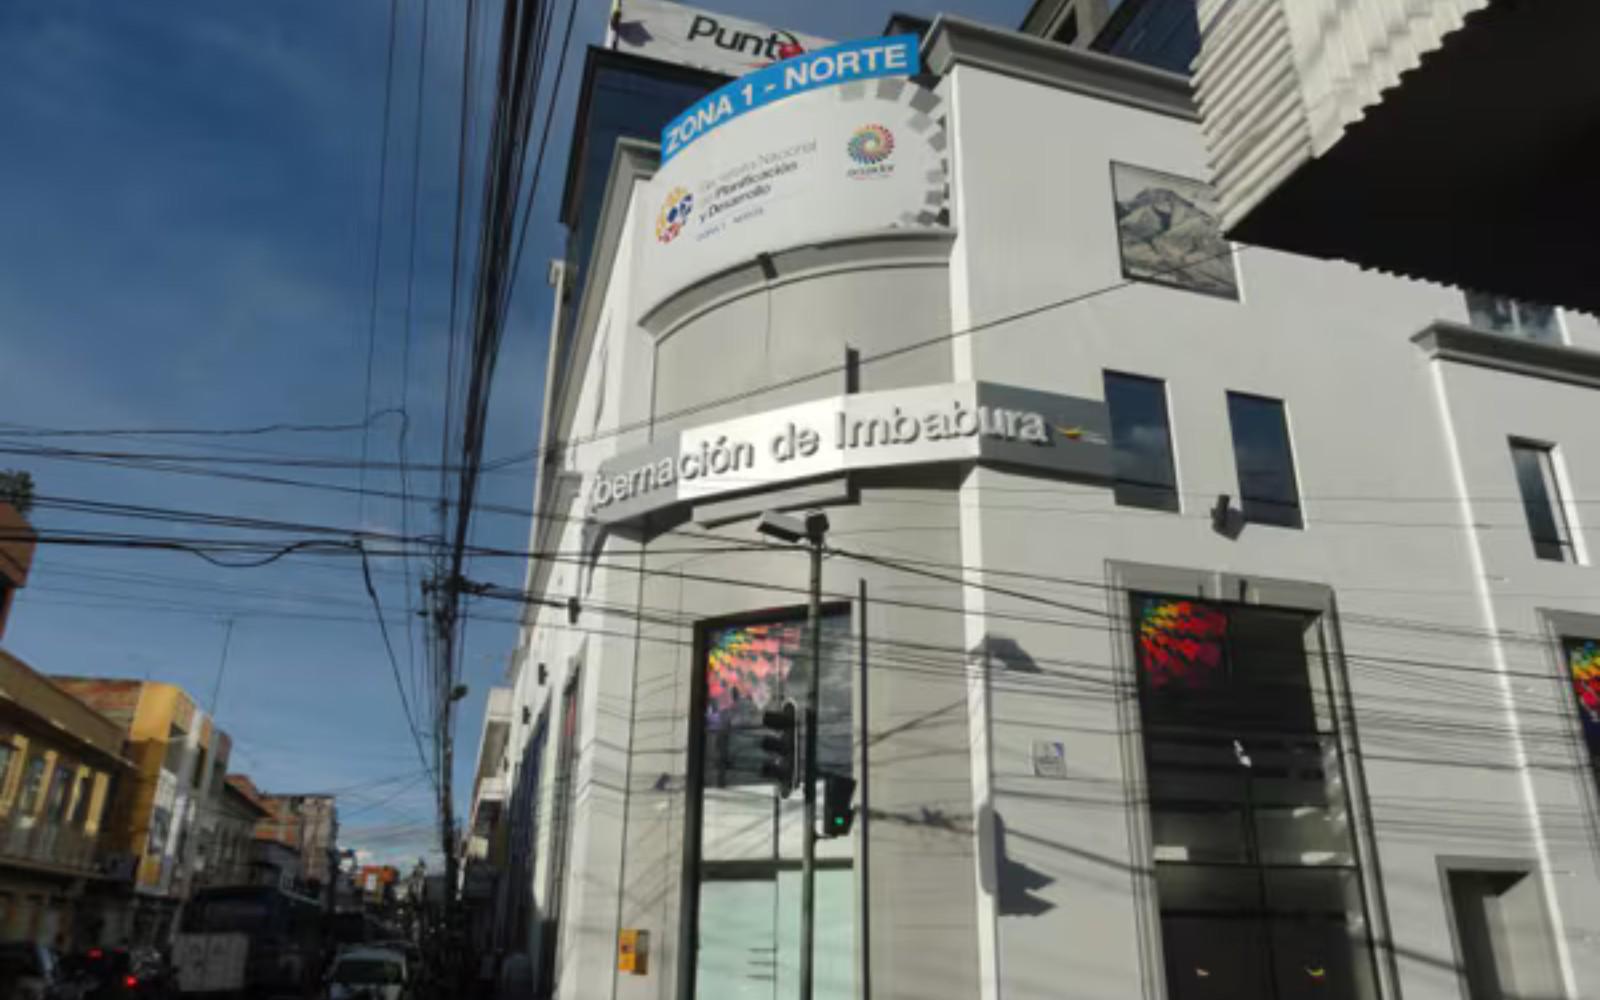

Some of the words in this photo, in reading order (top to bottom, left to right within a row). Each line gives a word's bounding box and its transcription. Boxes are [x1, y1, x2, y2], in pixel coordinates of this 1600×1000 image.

[666, 94, 734, 154] ZONA
[741, 84, 754, 106] 1
[784, 43, 908, 91] NORTE
[708, 184, 772, 218] Desarrollo
[590, 435, 755, 512] bernación
[773, 422, 820, 463] de
[834, 401, 1049, 450] Imbabura
